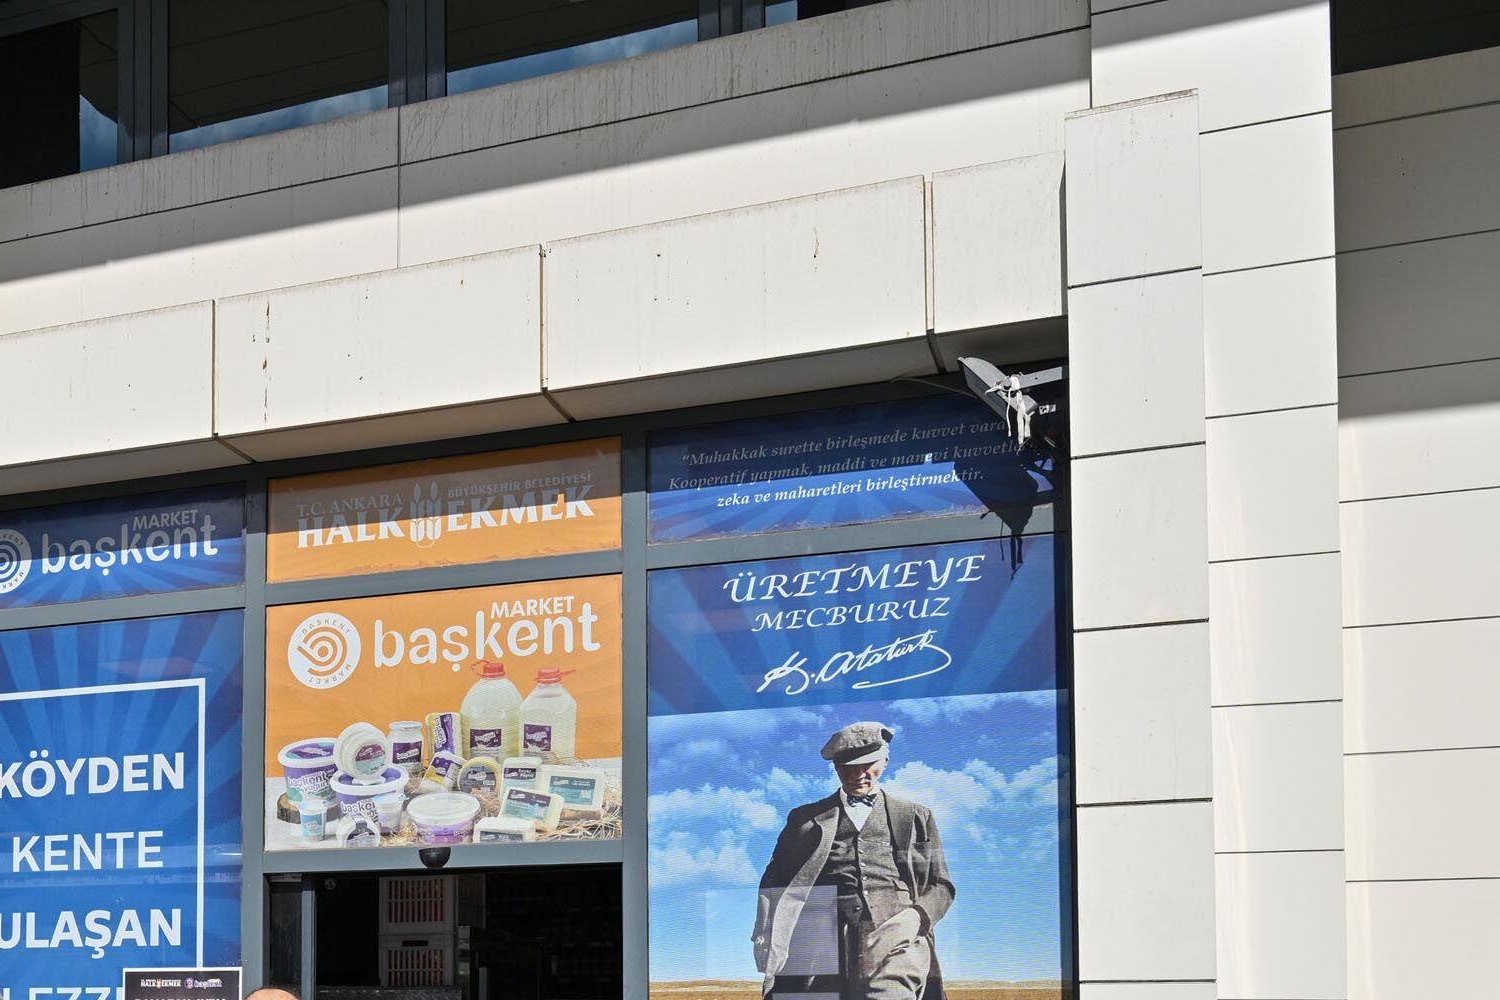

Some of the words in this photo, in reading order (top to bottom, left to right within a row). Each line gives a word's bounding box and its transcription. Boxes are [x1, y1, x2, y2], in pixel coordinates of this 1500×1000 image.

[771, 440, 823, 457] surette
[826, 429, 908, 451] birleşmede
[911, 423, 966, 441] kuvvet
[668, 468, 750, 492] Kooperatif
[749, 463, 813, 487] yapmak,
[818, 456, 866, 474] maddi
[870, 456, 887, 467] ve
[891, 446, 949, 466] manevi
[716, 492, 750, 508] zeka
[754, 492, 771, 504] ve
[774, 479, 862, 501] maharetleri
[866, 467, 984, 492] birleştirmektir.
[295, 502, 327, 518] T.C.
[329, 493, 404, 513] ANKARA
[447, 479, 523, 499] BÜYÜKŞEHİR
[524, 470, 593, 490] BELEDİYESİ
[132, 509, 199, 531] MARKET
[297, 506, 405, 549] HALK
[447, 484, 595, 533] EKMEK
[42, 514, 219, 576] başkent
[722, 554, 986, 604] ÜRETMEYE
[489, 595, 575, 620] MARKET
[751, 596, 951, 633] MECBURUZ
[374, 602, 601, 672] başkent
[12, 830, 164, 873] KENTE
